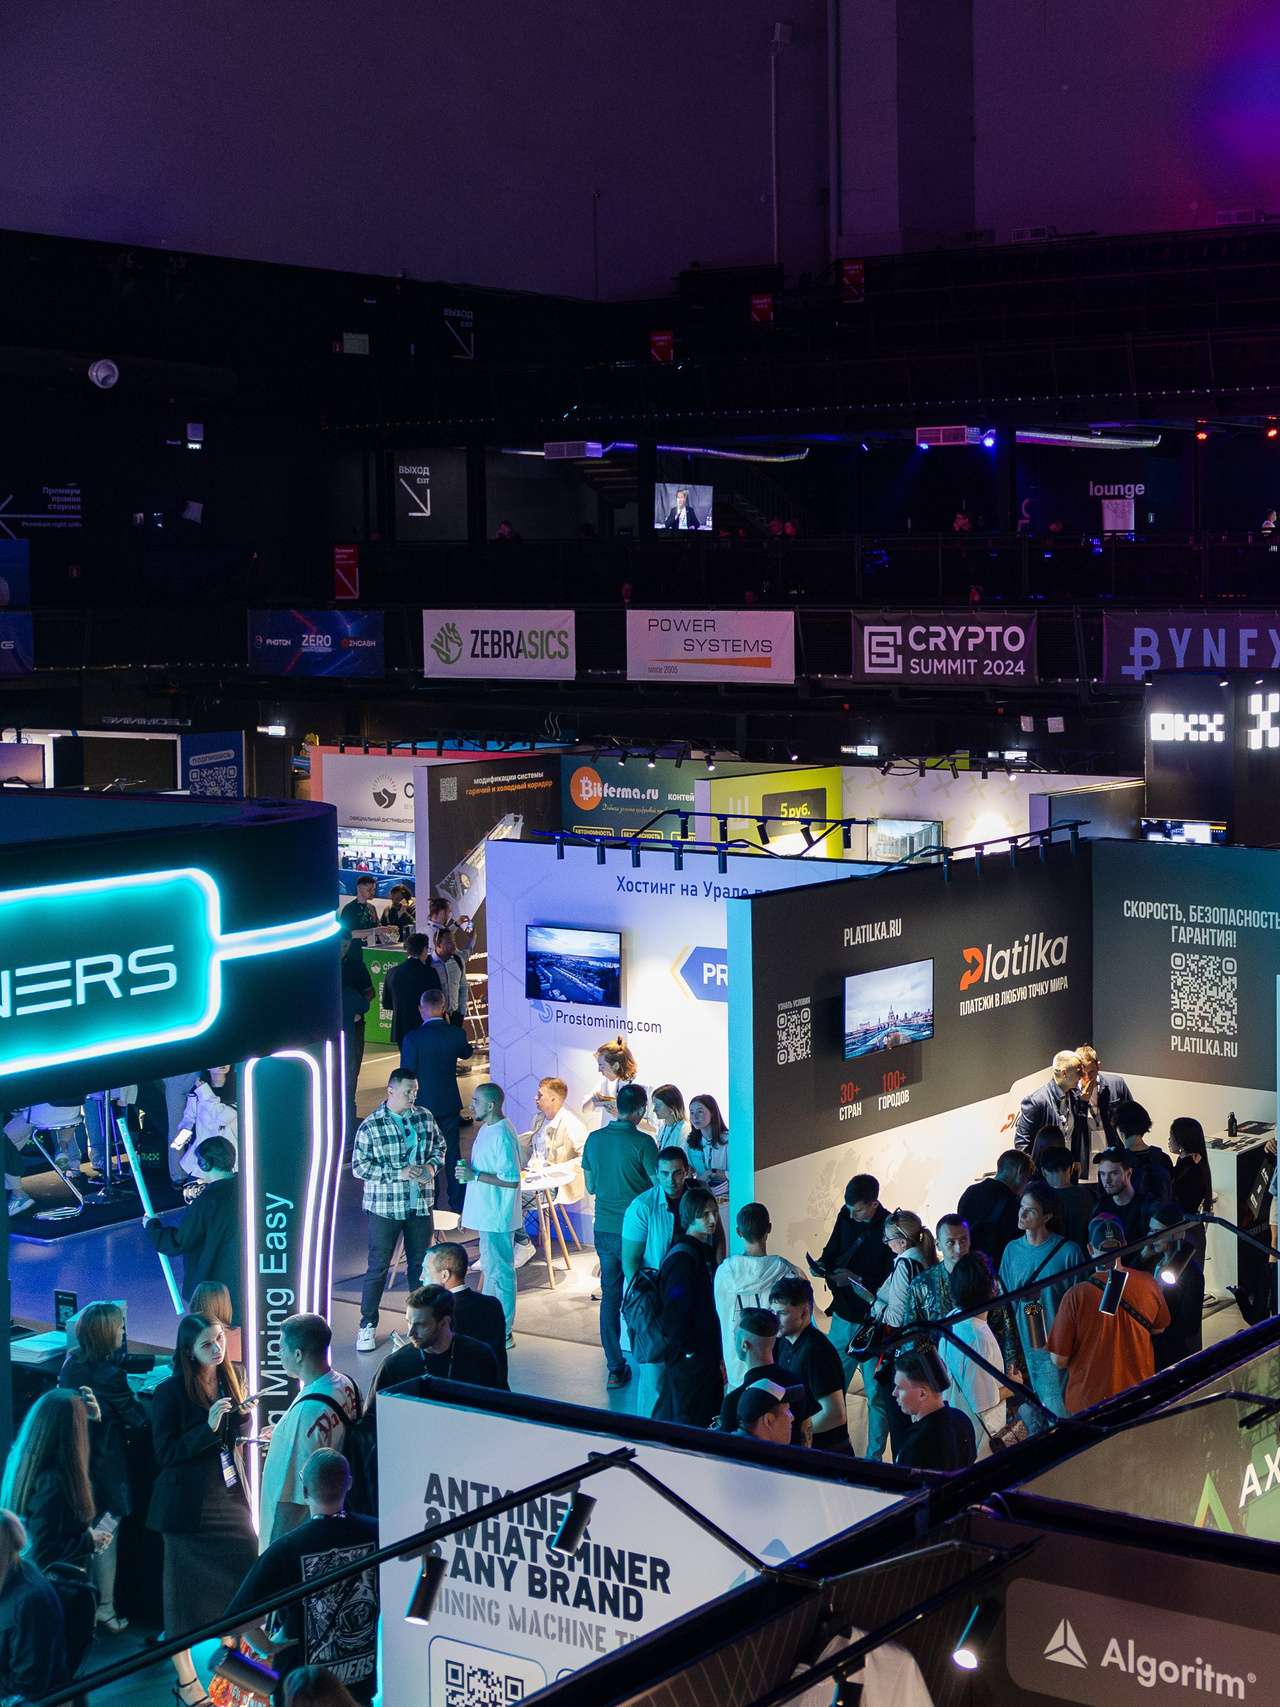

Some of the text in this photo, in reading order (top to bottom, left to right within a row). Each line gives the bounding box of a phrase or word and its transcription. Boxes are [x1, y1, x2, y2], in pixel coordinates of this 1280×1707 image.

[399, 466, 430, 475] ВЫХОД
[1089, 481, 1145, 498] lounge
[648, 619, 716, 632] POWER
[302, 635, 331, 646] ZERO
[470, 629, 570, 660] ZEBRASICS
[683, 639, 773, 653] SYSTEMS
[908, 625, 1026, 652] CRYPTO
[647, 665, 678, 674] since 2005
[909, 658, 1026, 676] SUMMIT 2024
[517, 772, 544, 780] системы
[580, 776, 659, 800] Bitferma.ru
[780, 802, 811, 818] 5 руб.
[616, 875, 749, 902] Хостинг на Урале
[1123, 900, 1186, 923] СКОРОСТЬ,
[844, 918, 902, 947] PLATILKA.RU
[1171, 926, 1237, 948] ГАРАНТИЯ!
[959, 931, 1069, 991] Platilka
[959, 976, 1069, 1017] ПЛАТЕЖИ В ЛЮБУЮ ТОЧКУ МИРА
[555, 1010, 663, 1034] Prostomining.com
[1171, 1036, 1238, 1058] PLATILKA.RU
[882, 1070, 907, 1092] 100+
[840, 1081, 861, 1104] 30+
[878, 1089, 910, 1111] ГОРОДОВ
[839, 1102, 862, 1121] СТРАН
[259, 1192, 294, 1275] Easy
[424, 1472, 592, 1541] ANTMINE
[527, 1563, 644, 1622] BRAND
